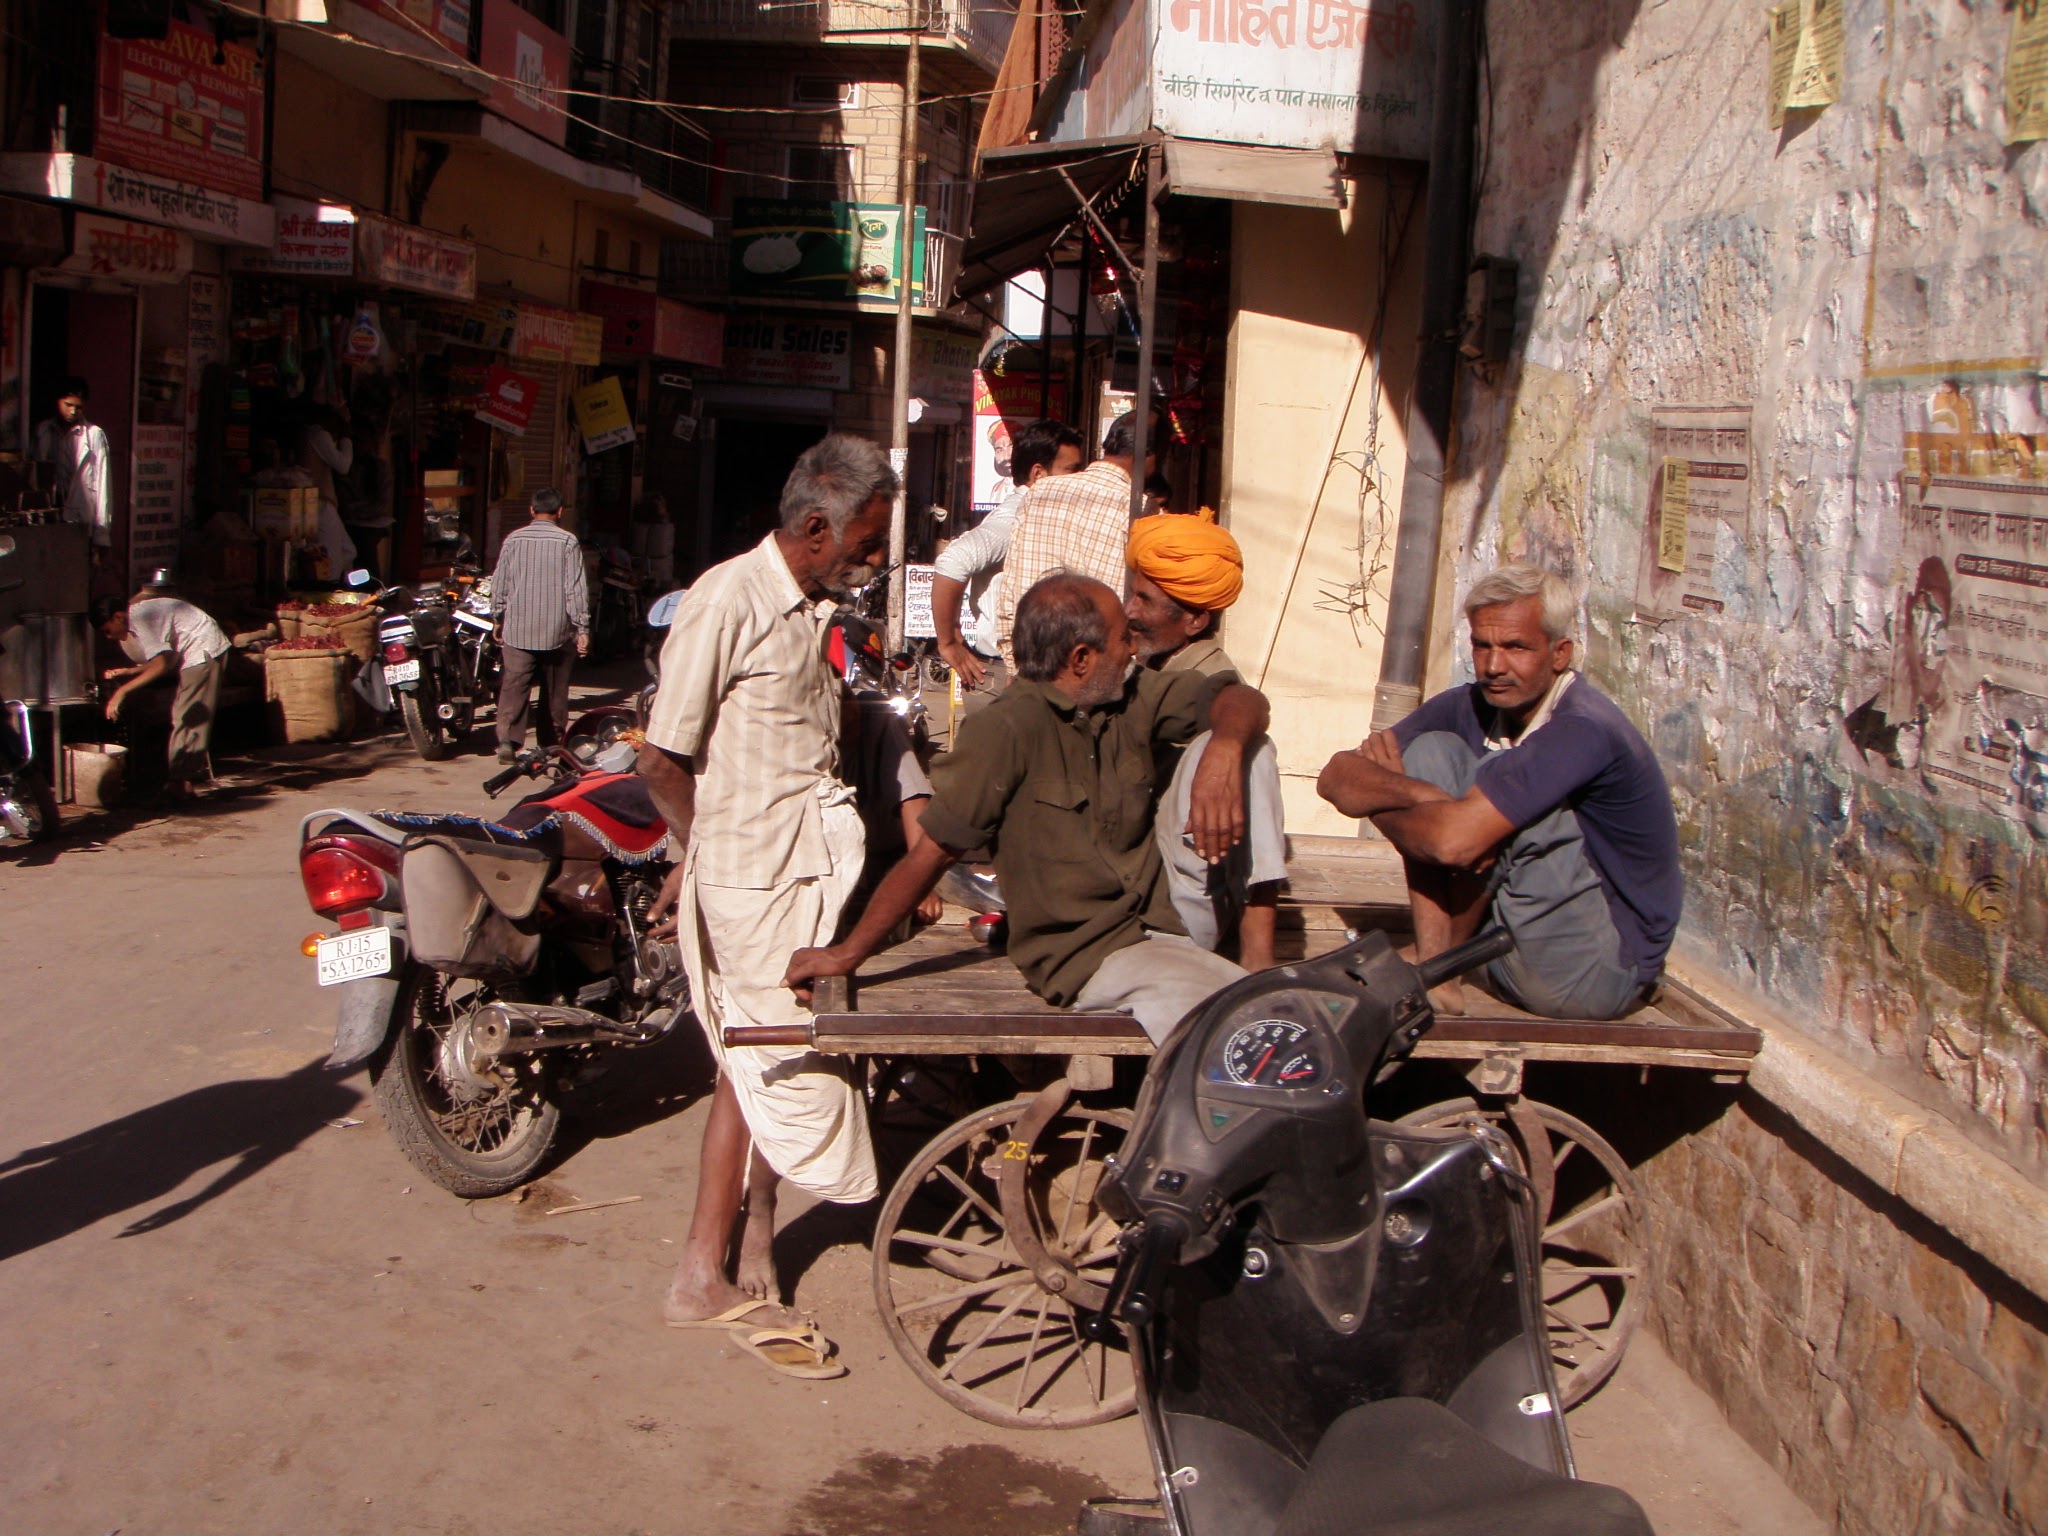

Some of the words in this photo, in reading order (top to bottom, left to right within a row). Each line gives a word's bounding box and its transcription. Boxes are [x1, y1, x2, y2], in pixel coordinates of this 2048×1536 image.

[127, 46, 184, 80] ELECTRIC
[200, 72, 246, 100] REPAIRS
[1275, 88, 1305, 109] पान
[782, 324, 848, 355] Sales
[960, 621, 978, 631] VIDE
[1004, 1140, 1029, 1161] 25
